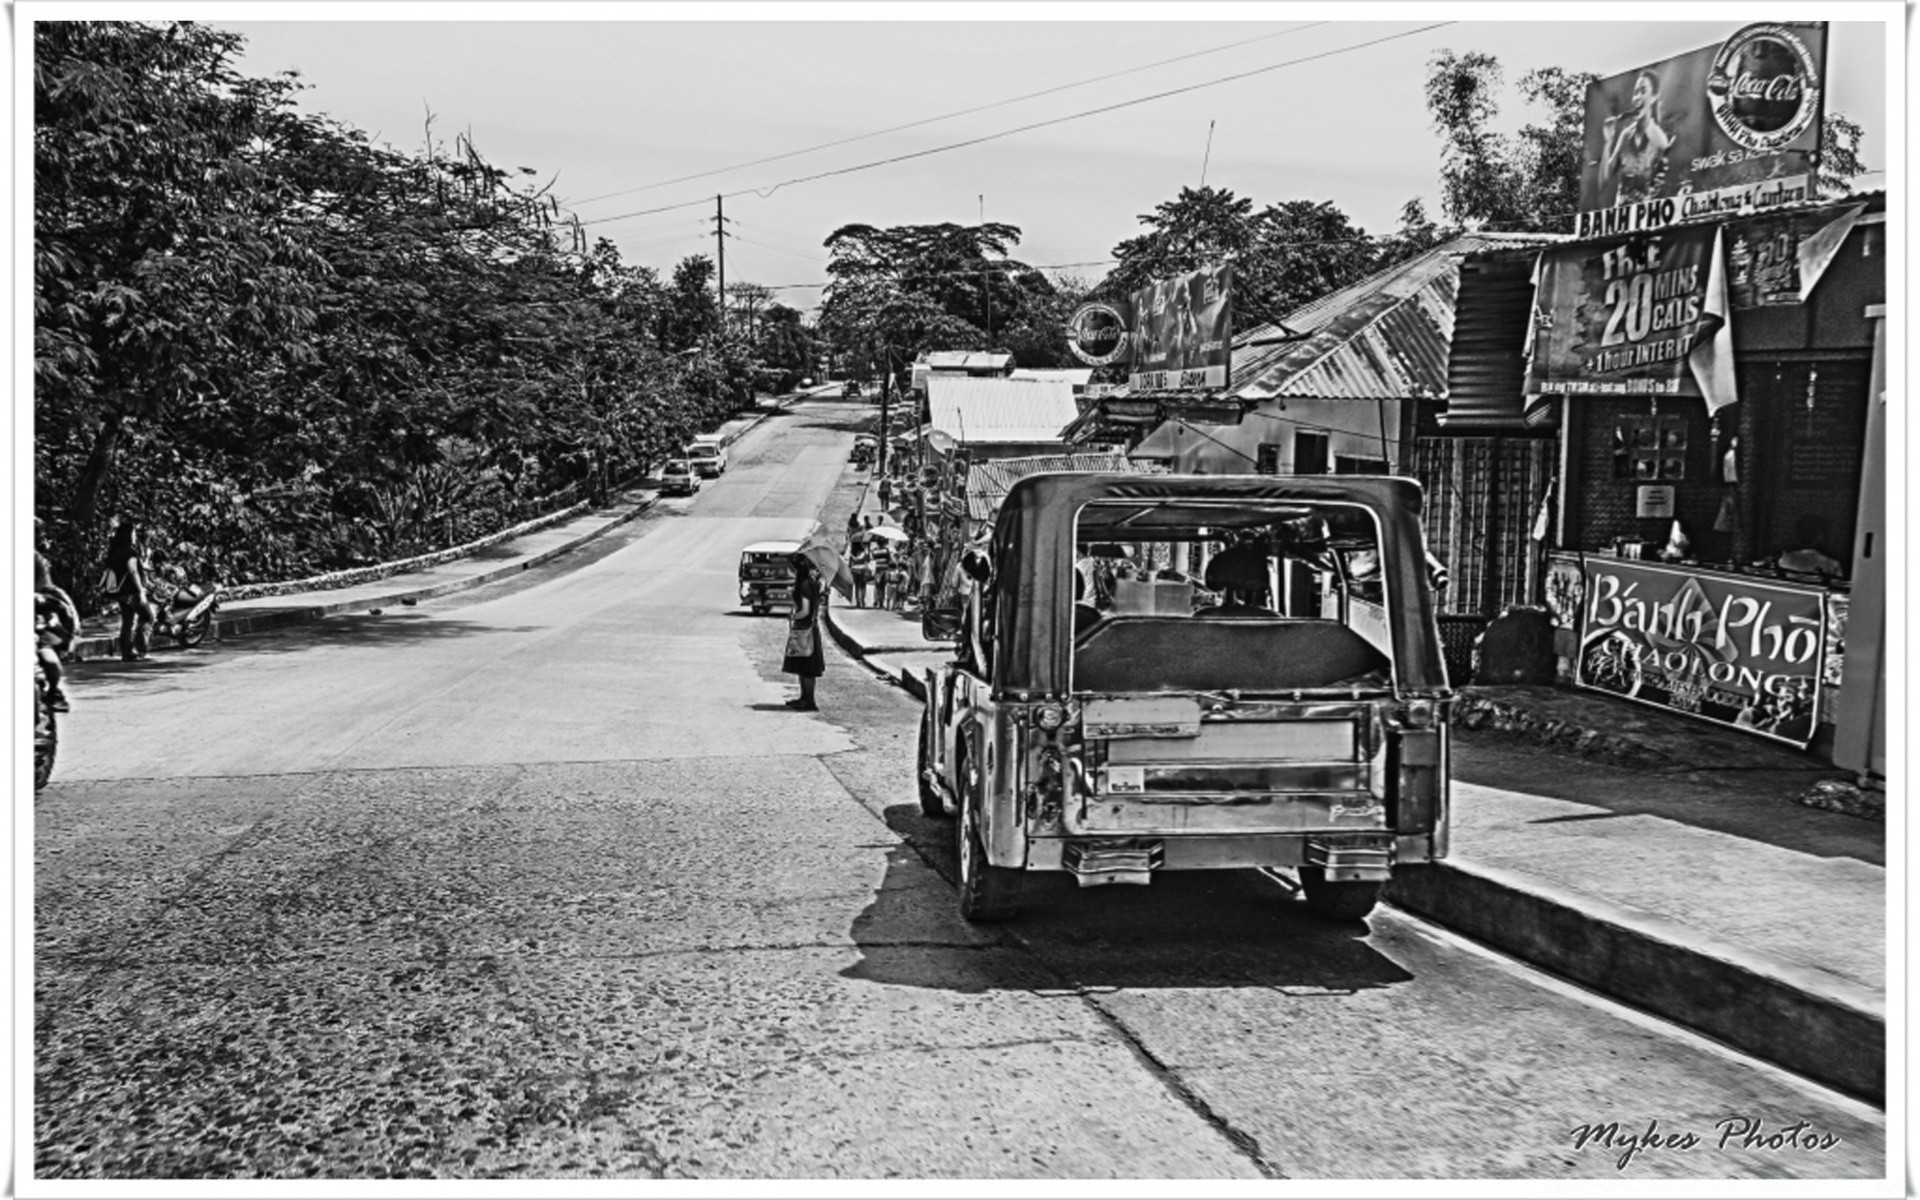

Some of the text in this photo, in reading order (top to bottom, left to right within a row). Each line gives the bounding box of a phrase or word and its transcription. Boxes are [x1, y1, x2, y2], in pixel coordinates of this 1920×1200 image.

[1579, 204, 1631, 238] BANH
[1635, 198, 1675, 231] PHO
[1602, 243, 1661, 280] FRE
[1600, 272, 1654, 348] 20
[1655, 264, 1699, 300] MINS
